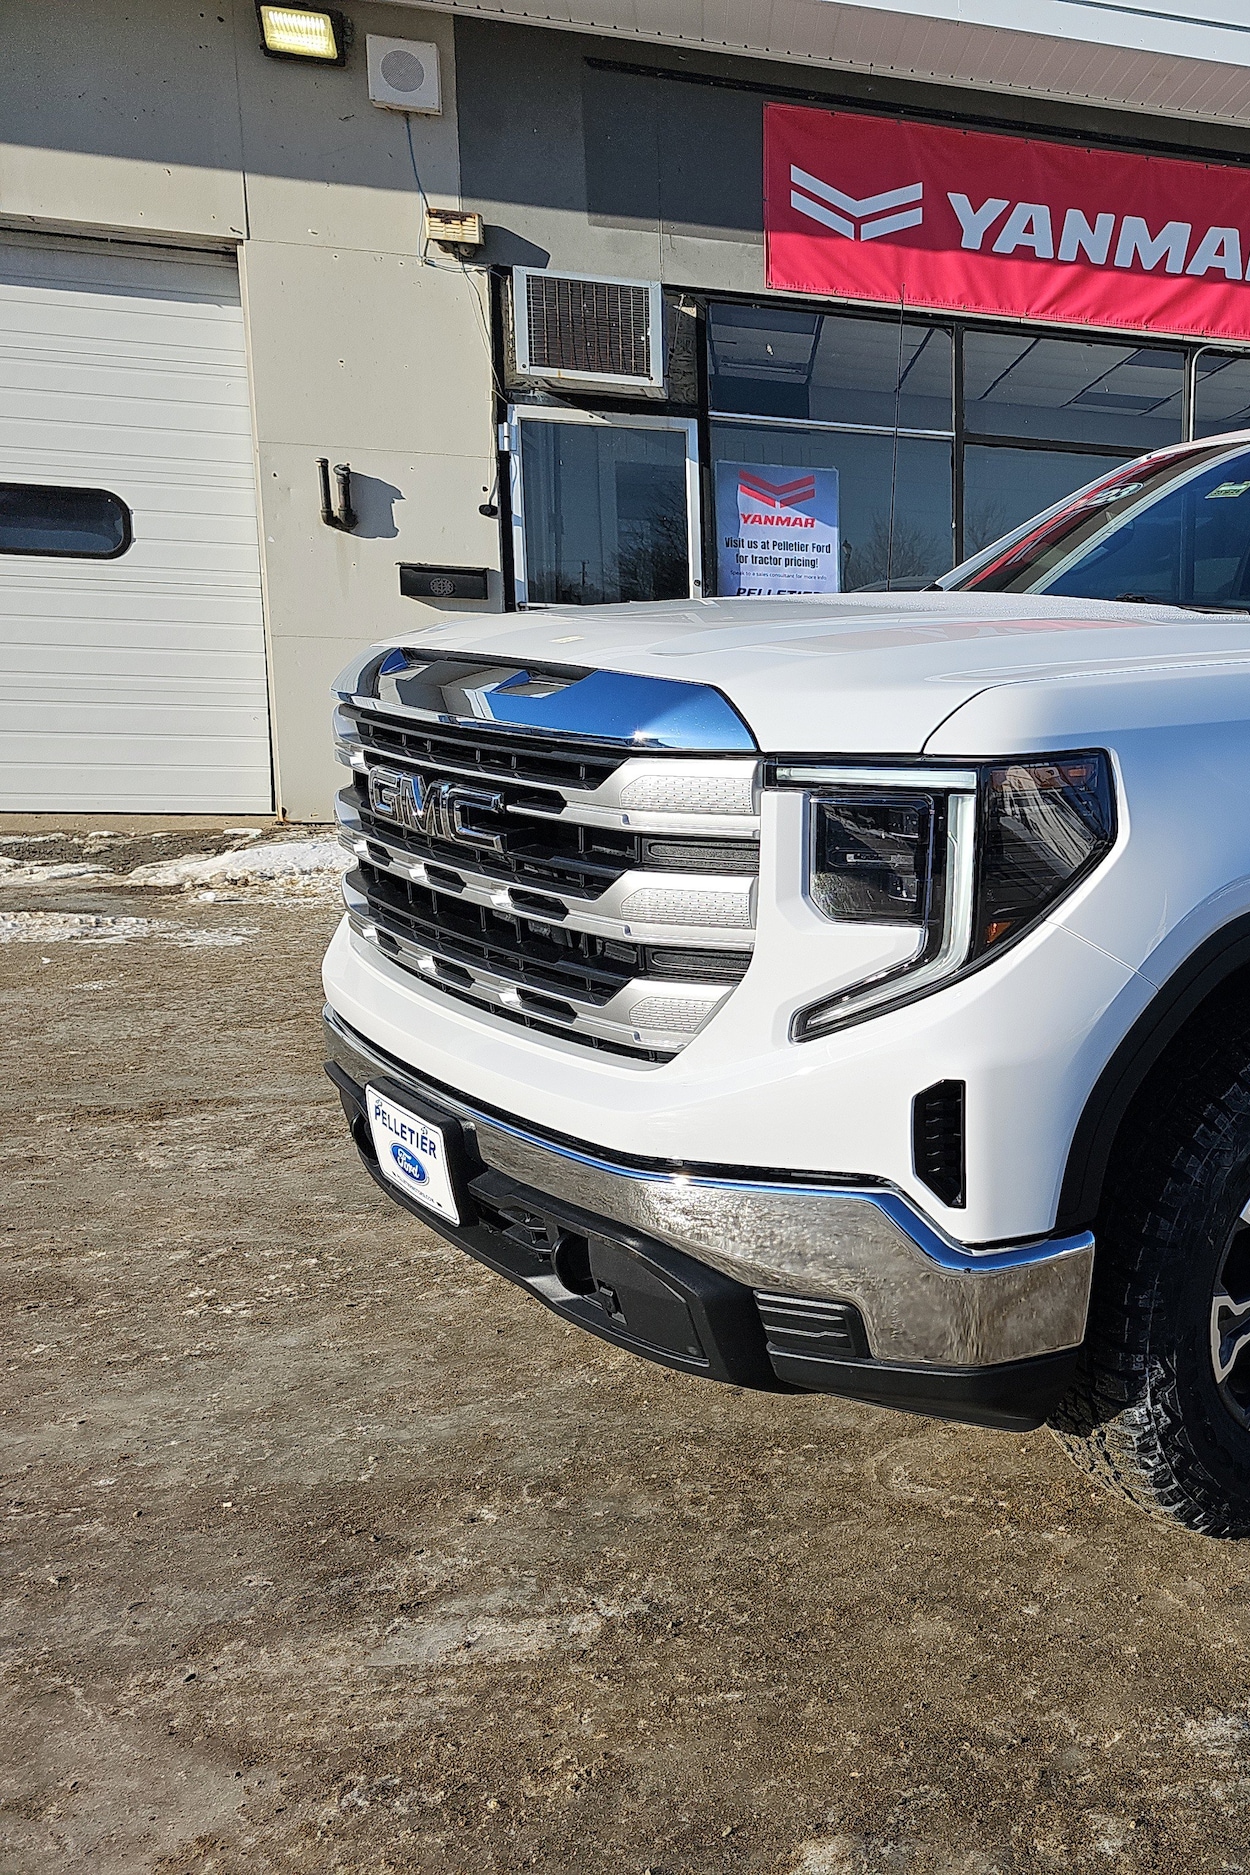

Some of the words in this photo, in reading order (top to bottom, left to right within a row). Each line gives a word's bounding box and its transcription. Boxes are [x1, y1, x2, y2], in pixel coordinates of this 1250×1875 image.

[740, 513, 816, 528] YANMAR
[725, 537, 745, 549] Visit
[747, 539, 759, 550] us
[760, 540, 770, 551] at
[772, 540, 809, 552] Pelletier
[811, 542, 831, 554] Ford
[736, 553, 748, 564] for
[751, 554, 782, 566] tractor
[784, 556, 819, 569] pricing!
[368, 764, 508, 853] GMC
[374, 1104, 438, 1160] PELLETIER
[396, 1147, 421, 1179] Ford
